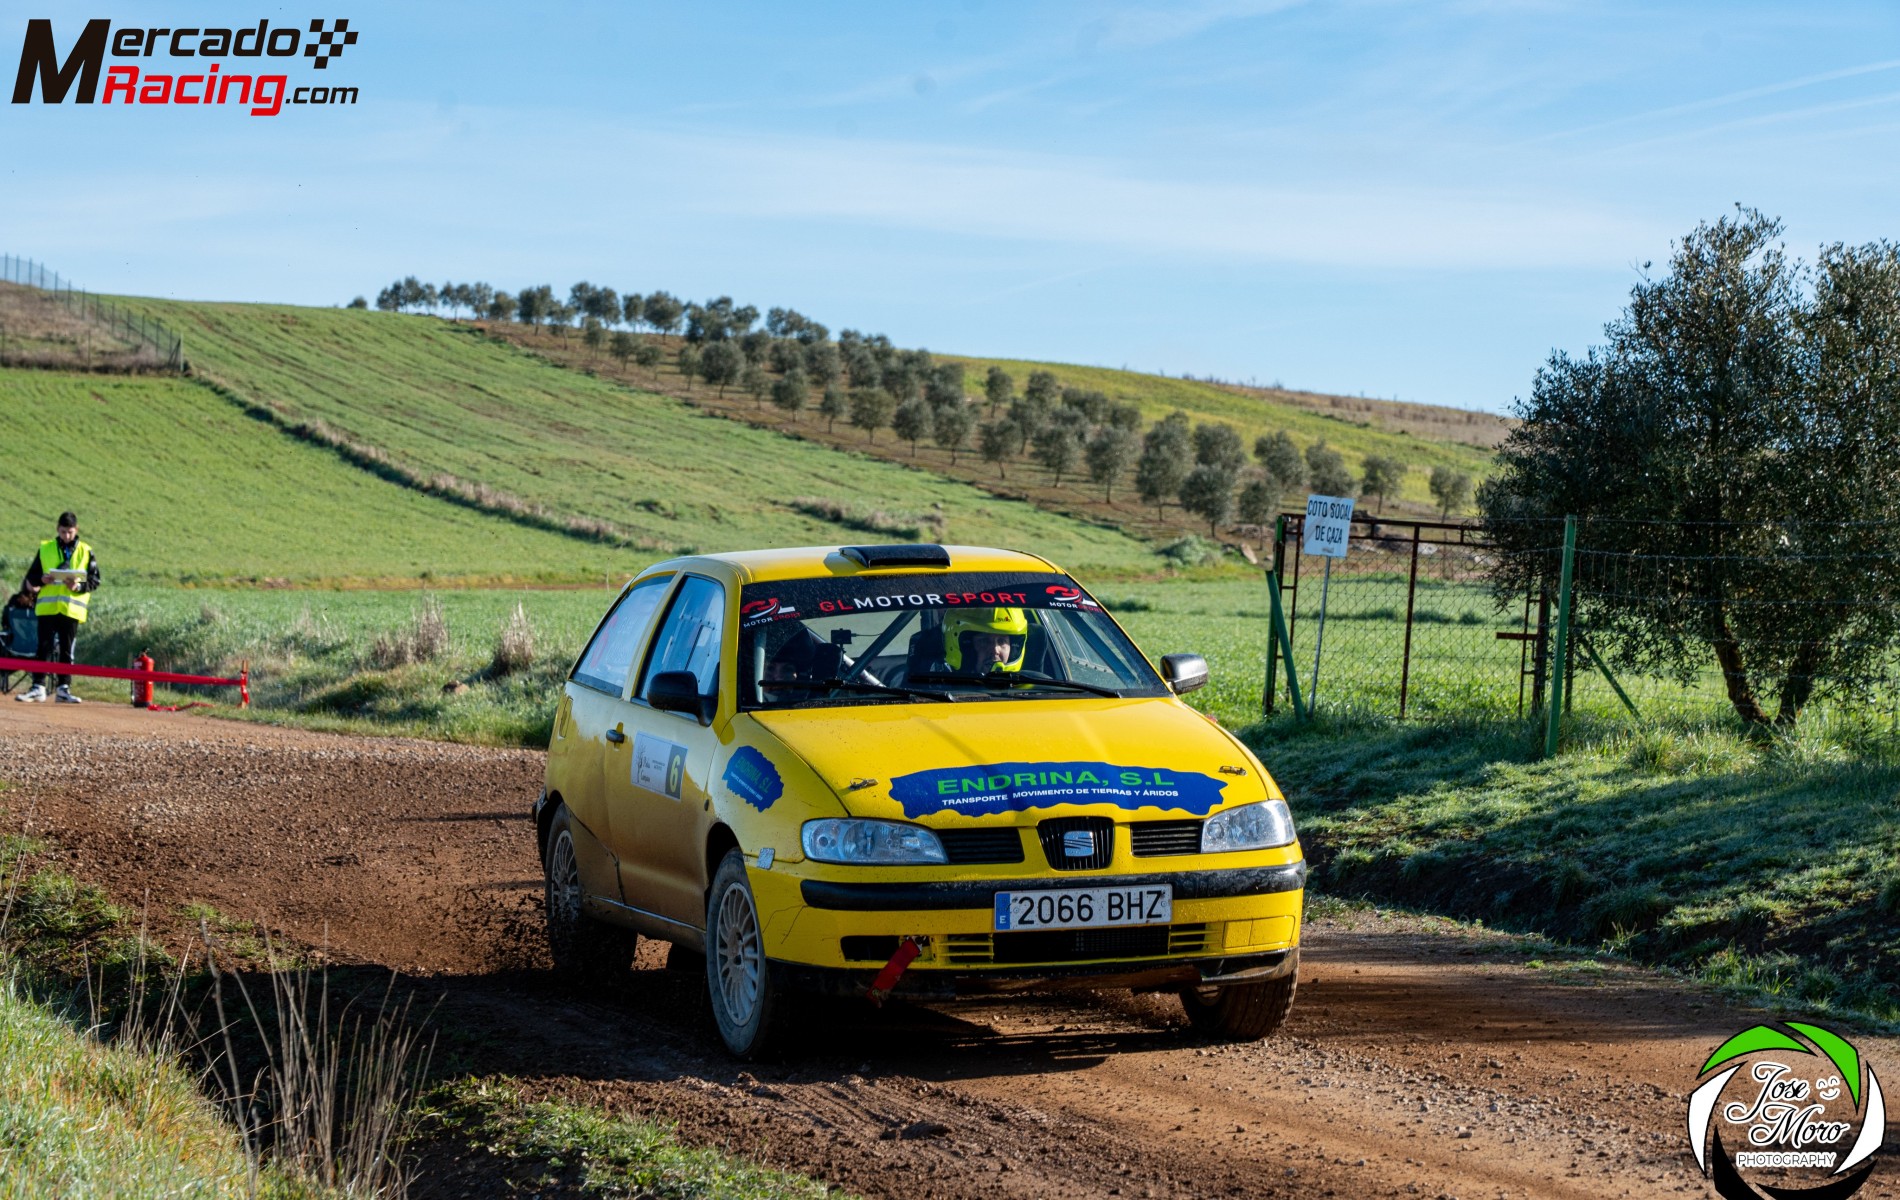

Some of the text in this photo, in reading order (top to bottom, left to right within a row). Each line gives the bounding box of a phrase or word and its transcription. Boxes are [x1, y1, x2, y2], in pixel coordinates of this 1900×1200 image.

[1308, 499, 1328, 518] COTO
[1315, 525, 1326, 542] DE
[670, 754, 681, 793] 6
[1119, 771, 1175, 786] S.L
[942, 794, 1009, 806] TRANSPORTE
[1013, 788, 1074, 799] MOVIMIENTO
[1091, 788, 1132, 796] TIERRAS
[1142, 788, 1179, 797] ÁRIDOS
[1018, 890, 1163, 925] 2066 BHZ
[1000, 916, 1006, 924] E
